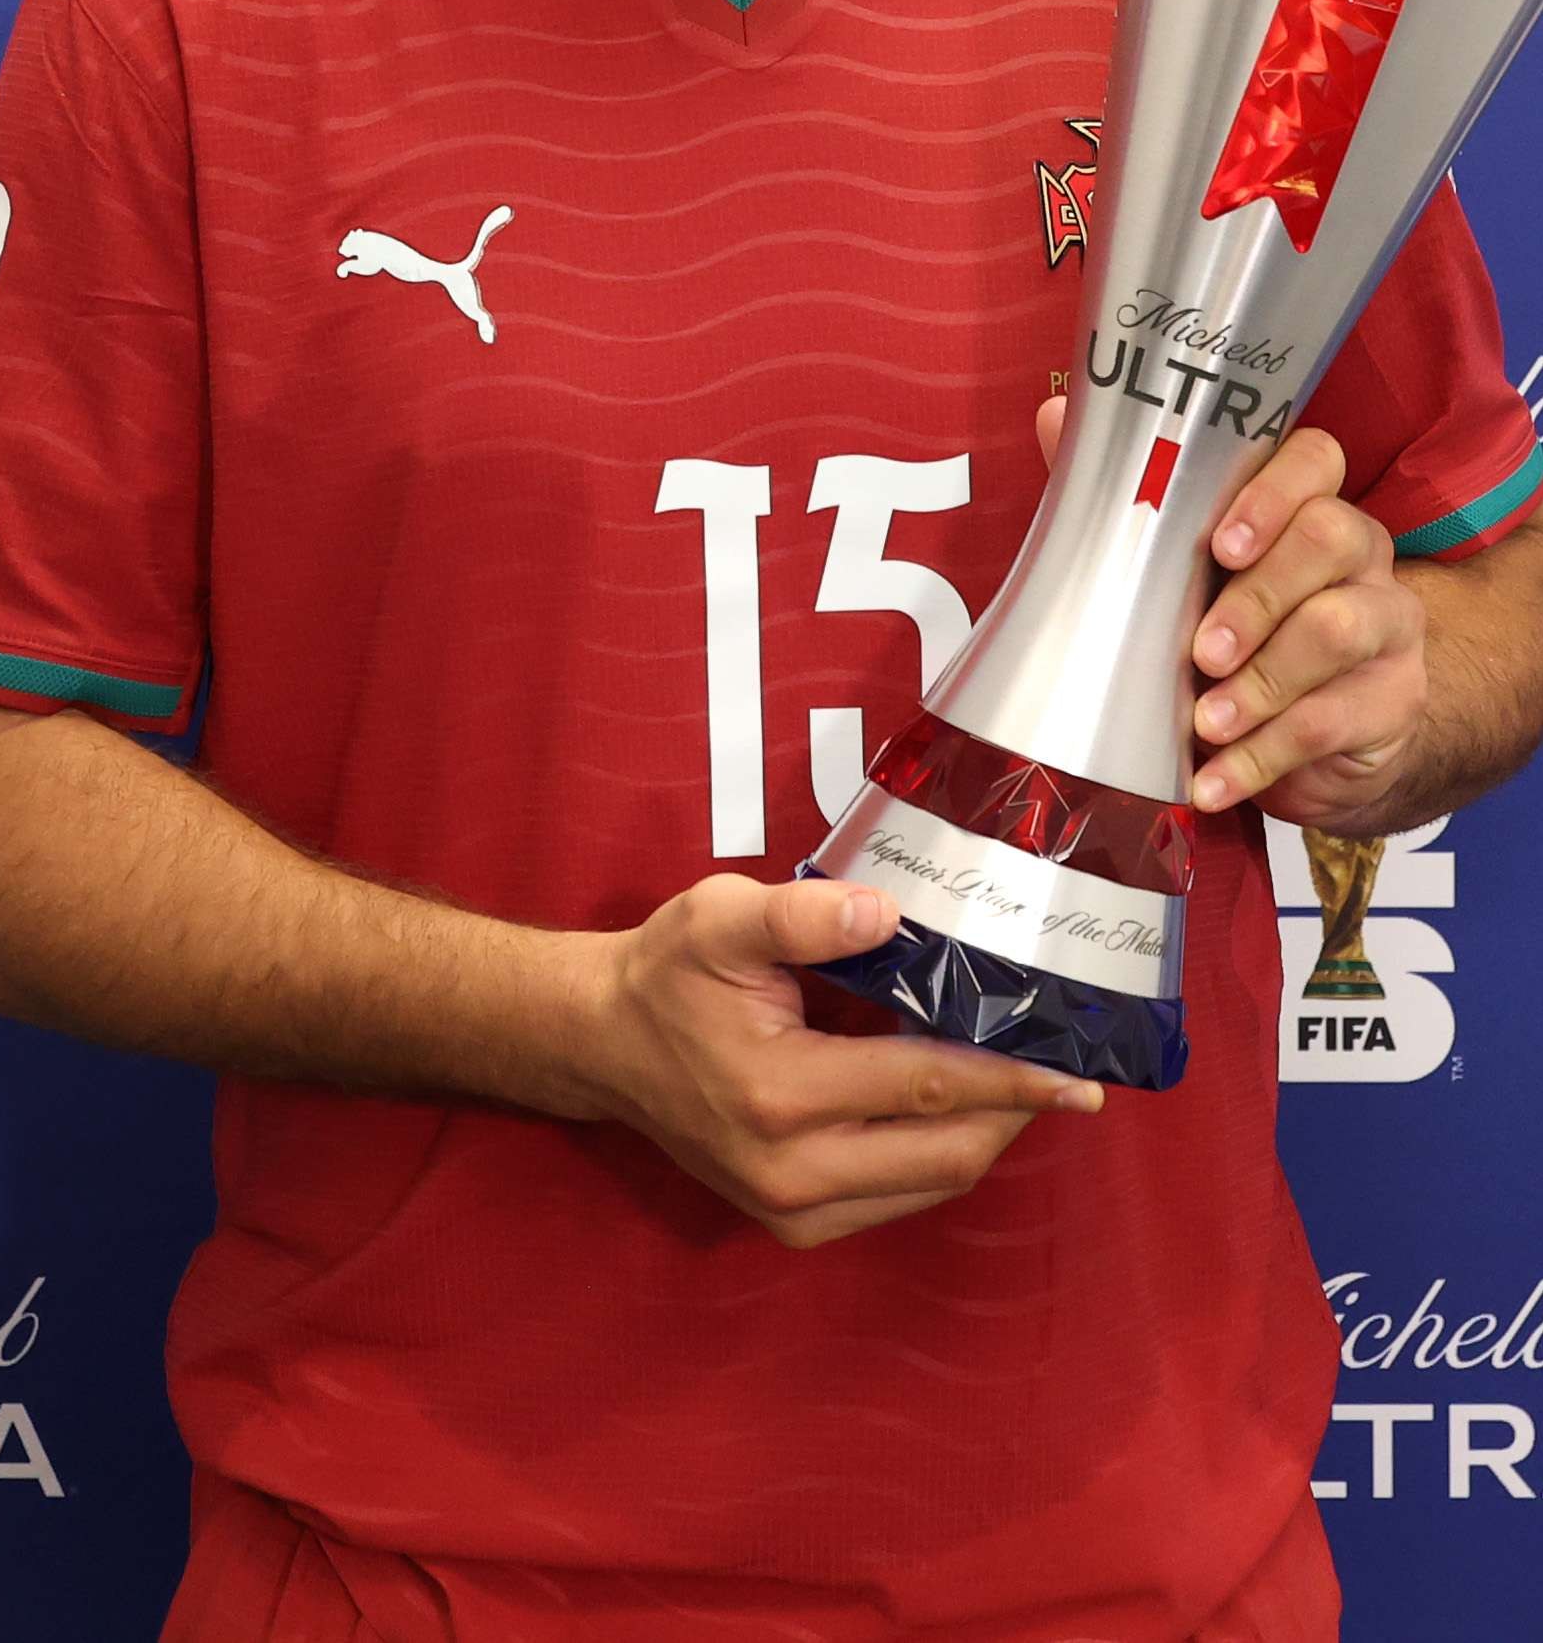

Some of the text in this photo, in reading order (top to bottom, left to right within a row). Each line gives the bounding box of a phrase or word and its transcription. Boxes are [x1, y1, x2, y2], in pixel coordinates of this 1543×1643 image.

[1116, 288, 1294, 375] Michelob
[1087, 330, 1293, 448] ULTRA
[654, 453, 973, 858] 15
[861, 829, 946, 883] Superior
[1038, 910, 1090, 936] of
[1067, 916, 1106, 943] the
[1298, 1017, 1395, 1050] FIFA
